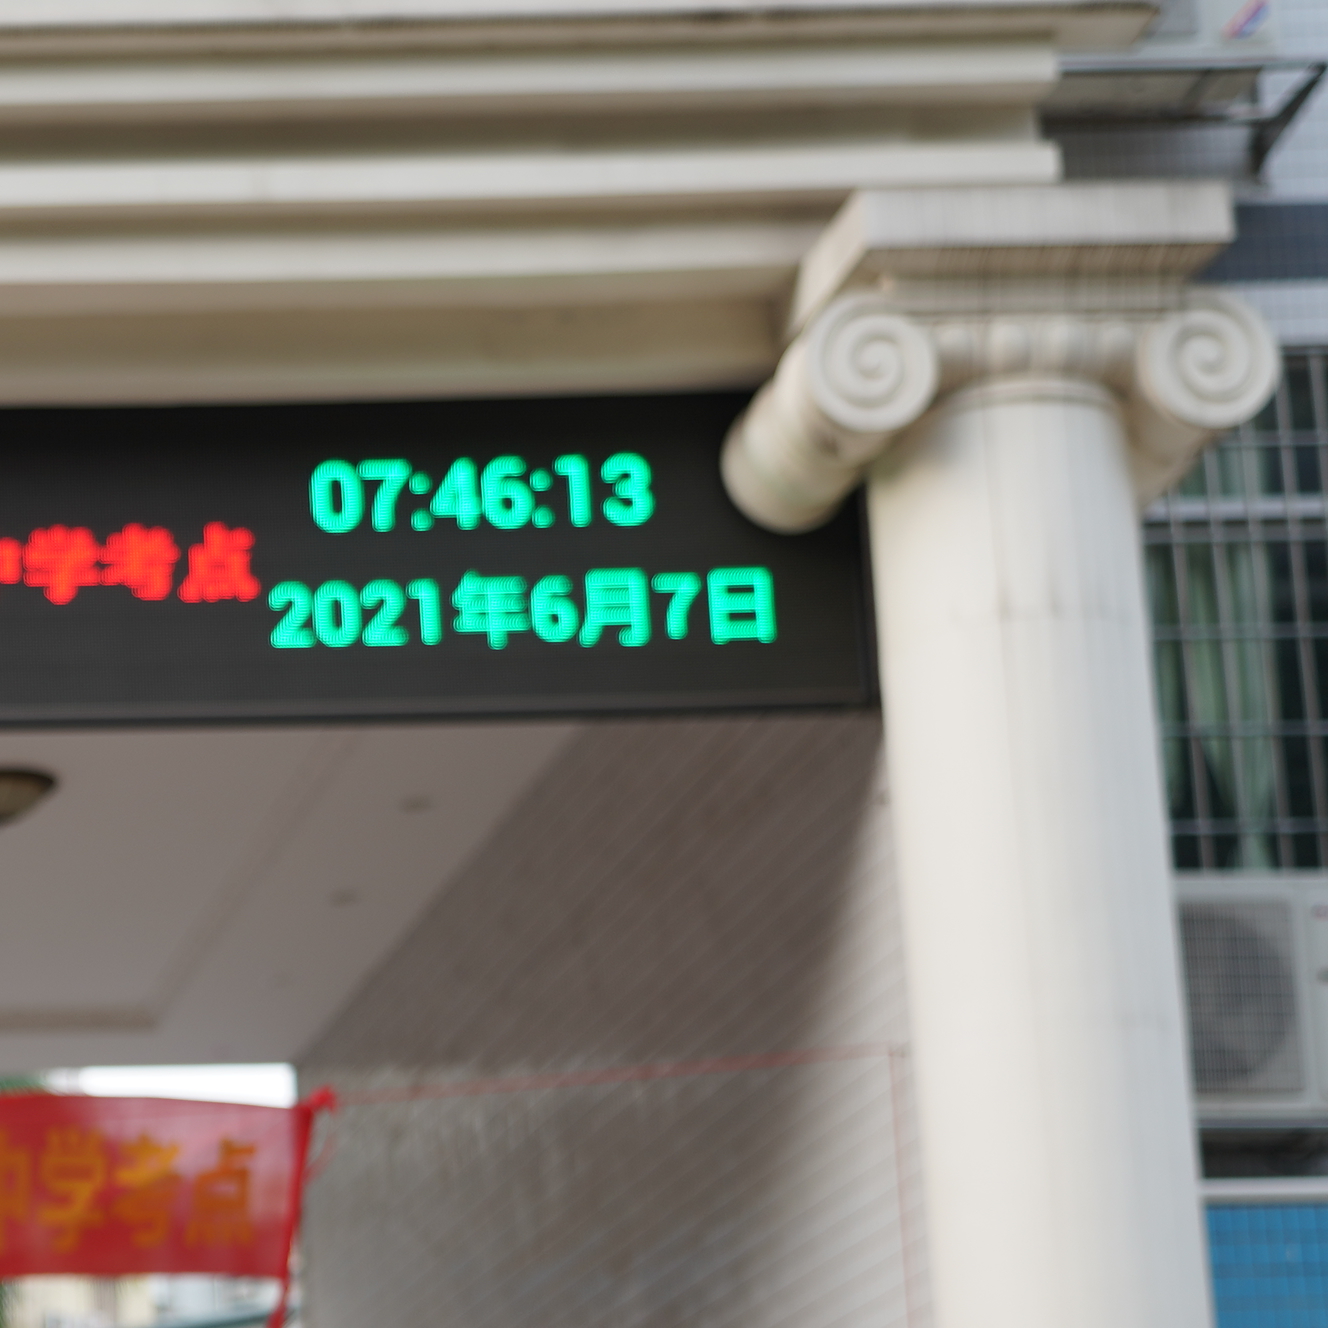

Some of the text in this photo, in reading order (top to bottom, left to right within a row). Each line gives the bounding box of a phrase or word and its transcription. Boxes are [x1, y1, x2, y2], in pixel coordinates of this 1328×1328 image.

[308, 452, 656, 534] 07:46:13
[267, 566, 777, 650] 2021年6月7日
